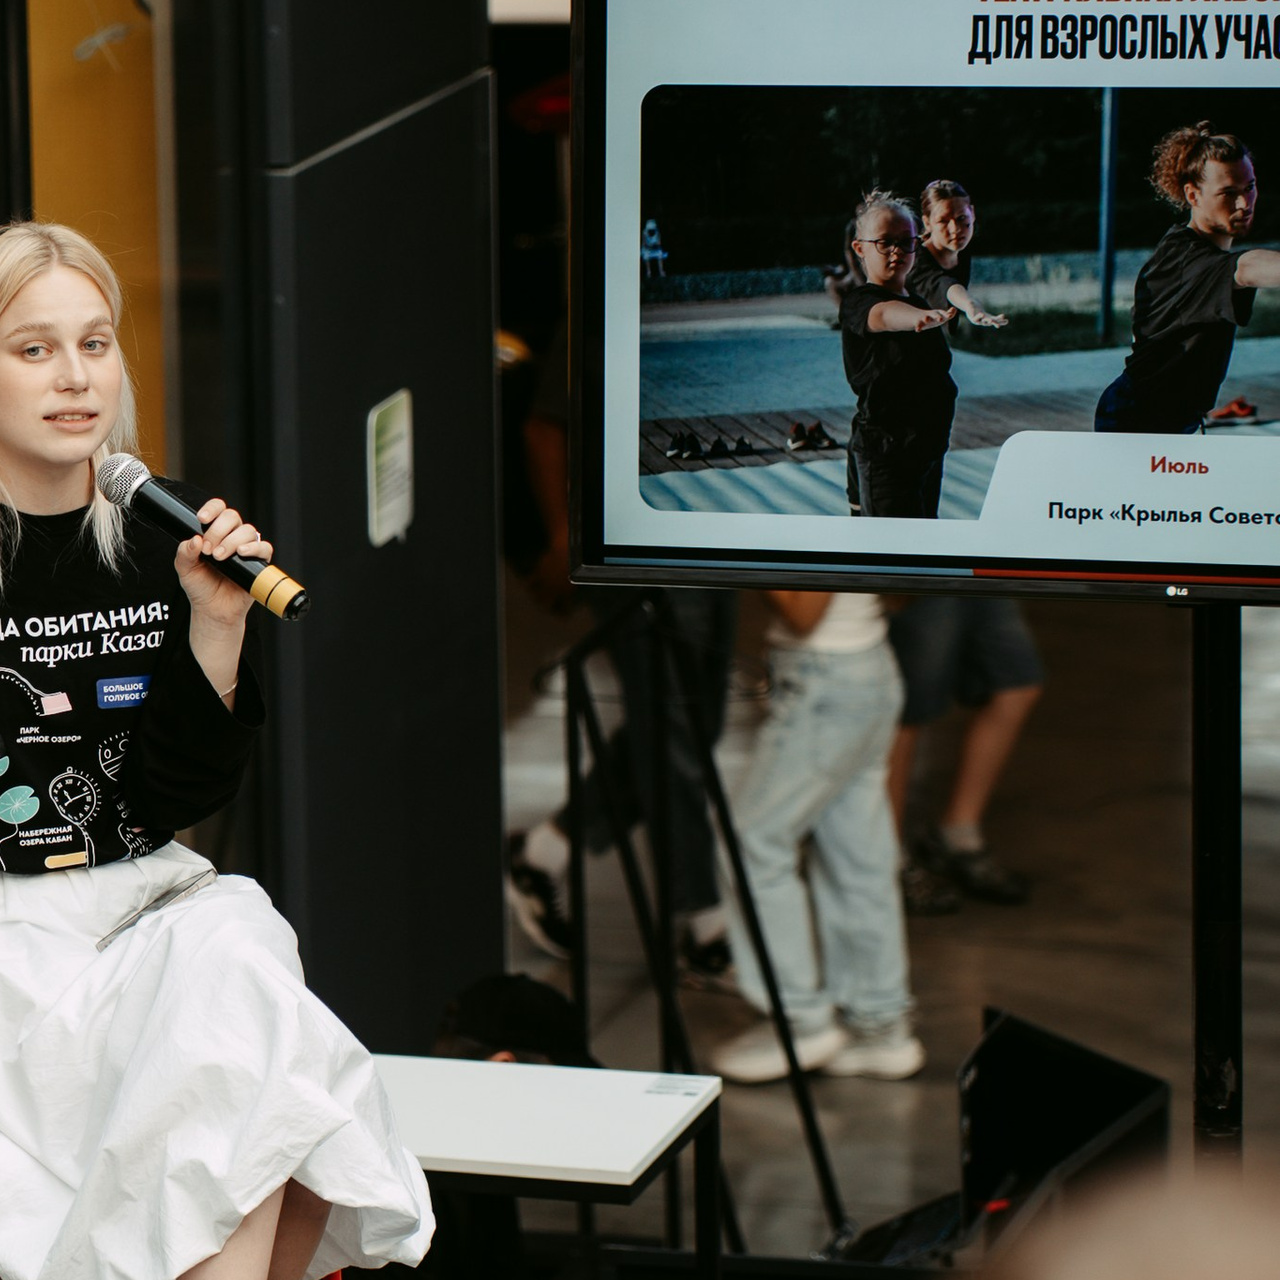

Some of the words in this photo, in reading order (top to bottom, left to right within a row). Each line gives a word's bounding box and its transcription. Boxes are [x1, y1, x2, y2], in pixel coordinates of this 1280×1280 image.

[968, 14, 1033, 65] ДЛЯ
[1040, 14, 1209, 60] ВЗРОСЛЫХ
[1150, 456, 1210, 475] Июль
[1048, 501, 1104, 525] Парк
[1110, 503, 1202, 526] «Крылья
[1177, 587, 1188, 596] LG
[24, 601, 169, 637] ОБИТАНИЯ:
[21, 640, 93, 668] парки
[103, 682, 144, 693] БОЛЬШОЕ
[104, 692, 140, 703] ГОЛУБОЕ
[19, 726, 40, 735] ПАРК
[19, 825, 73, 838] НАБЕРЕЖНАЯ
[19, 837, 45, 847] ОЗЕРА
[45, 834, 73, 844] КАБАН
